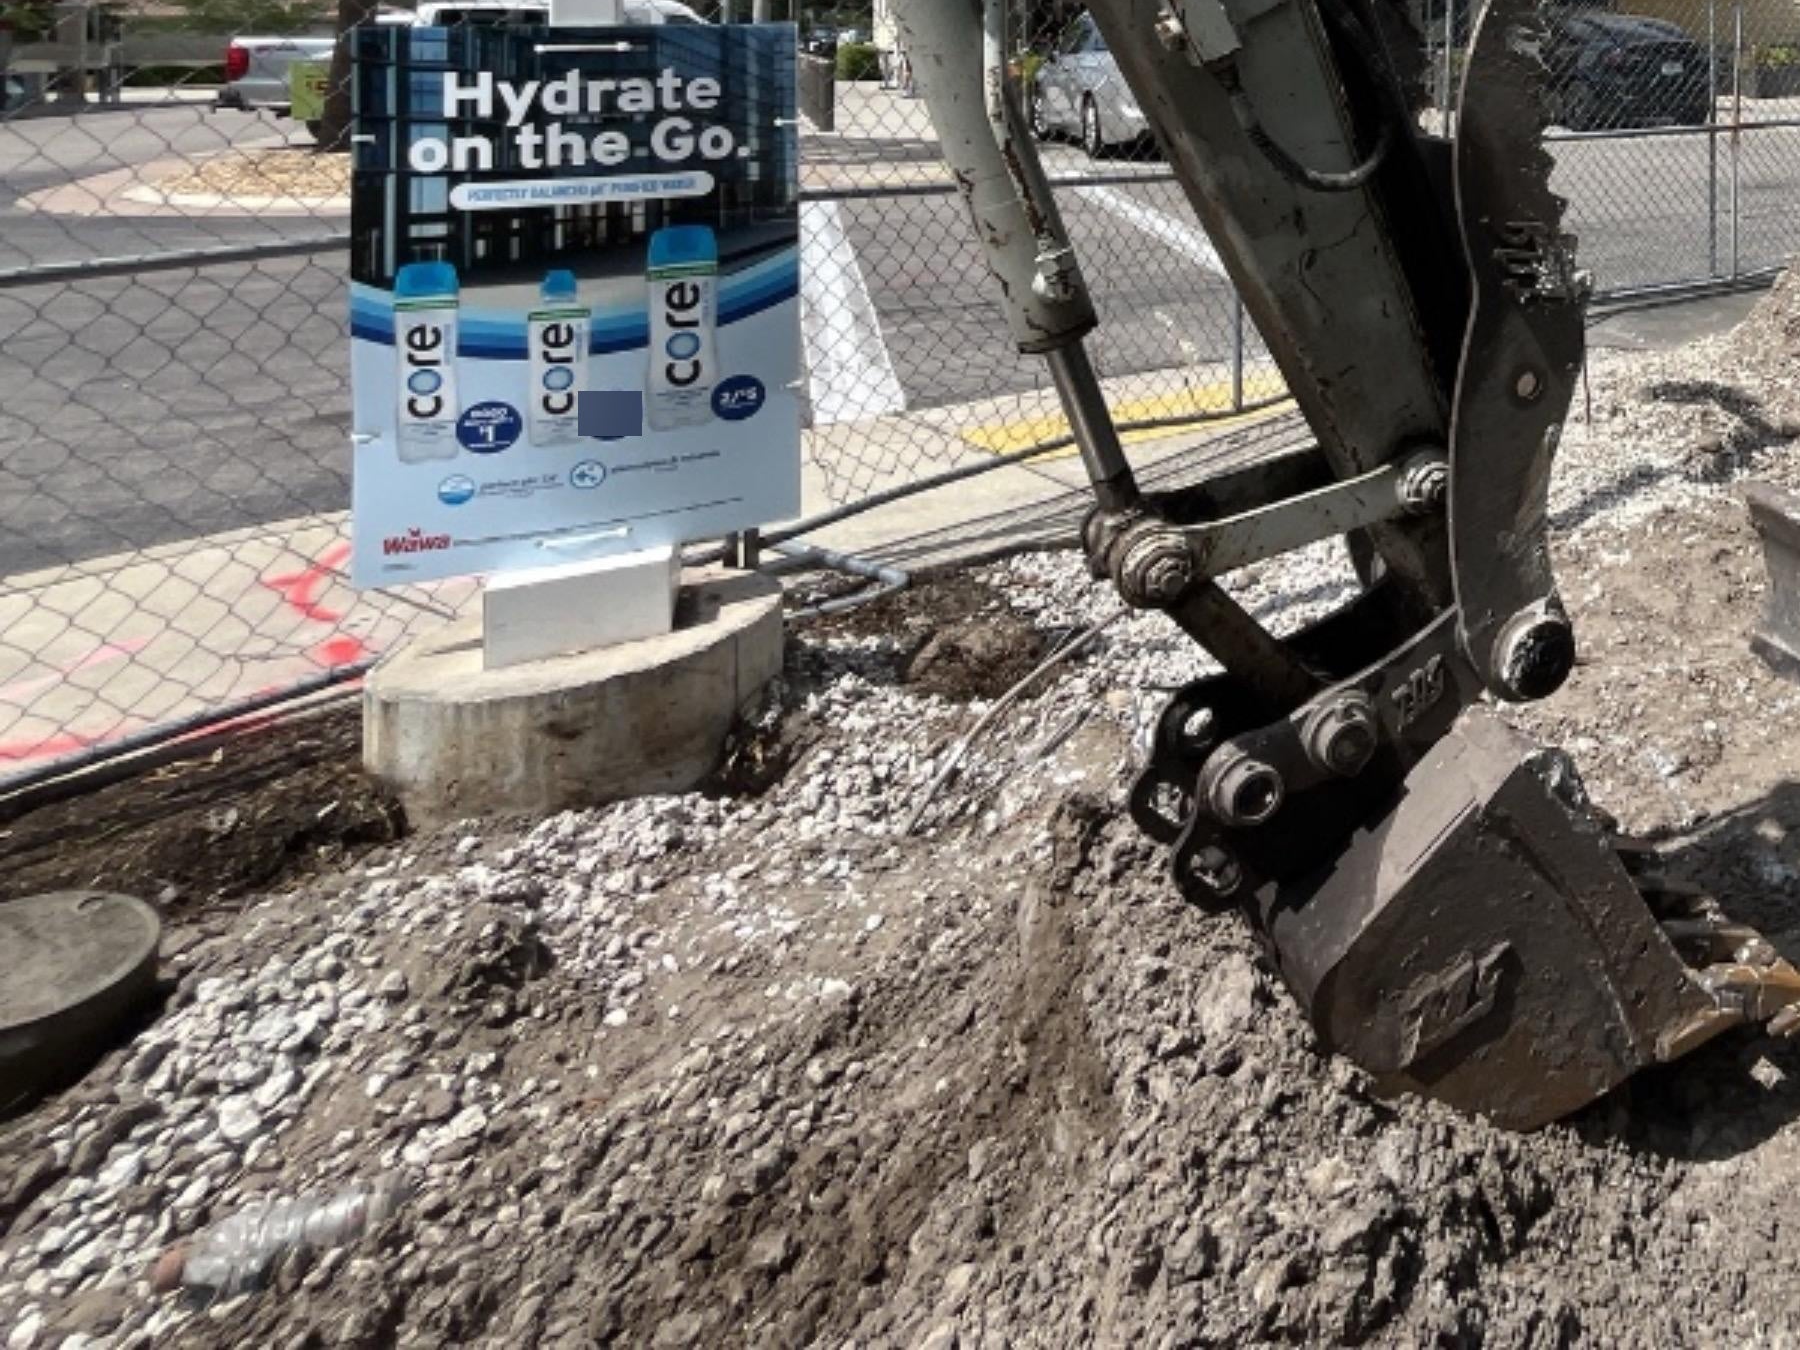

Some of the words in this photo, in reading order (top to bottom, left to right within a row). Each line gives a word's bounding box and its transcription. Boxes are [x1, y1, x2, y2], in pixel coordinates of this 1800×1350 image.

[443, 67, 722, 127] Hydrate
[407, 135, 494, 173] on
[516, 122, 630, 169] the
[650, 116, 752, 162] Go.
[406, 323, 443, 419] core
[542, 323, 575, 416] core
[666, 281, 702, 387] core
